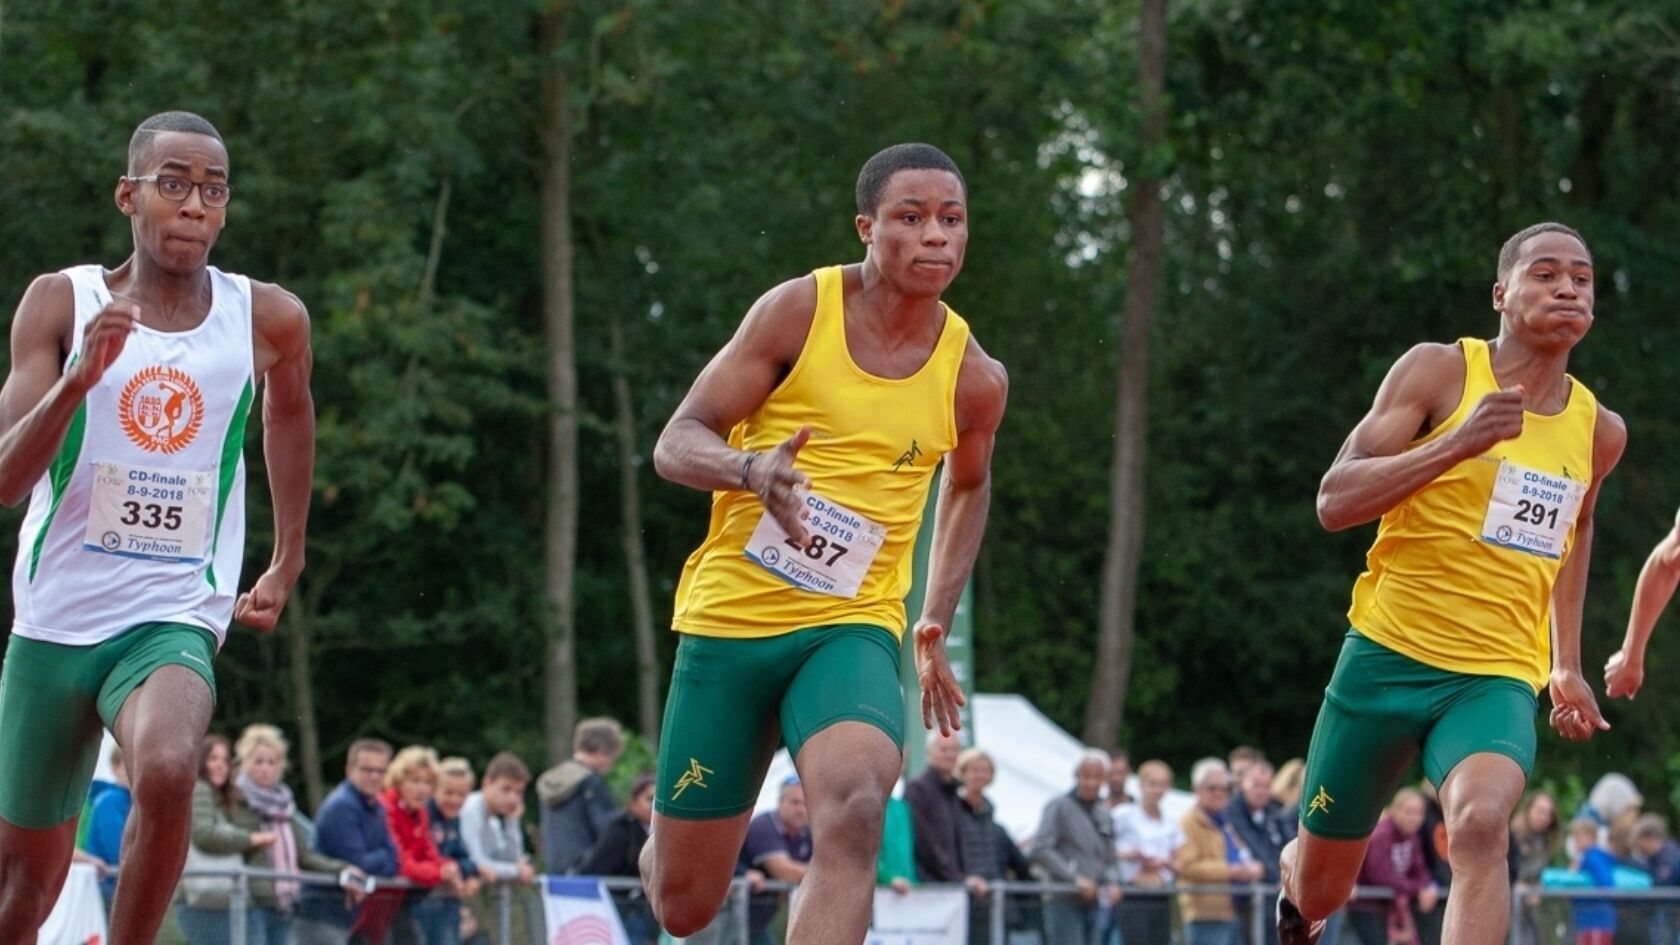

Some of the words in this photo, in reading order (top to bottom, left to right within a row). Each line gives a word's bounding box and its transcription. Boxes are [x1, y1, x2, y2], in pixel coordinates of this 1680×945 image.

[128, 470, 187, 486] CD-finale
[1524, 471, 1568, 491] CD-finale
[127, 485, 184, 501] 8-9-2018
[1521, 485, 1564, 504] 8-9-2018
[120, 501, 184, 531] 335
[806, 496, 861, 530] CD-finale
[1513, 498, 1560, 530] 291
[127, 538, 182, 554] Typhoon
[783, 559, 834, 590] Typhoon
